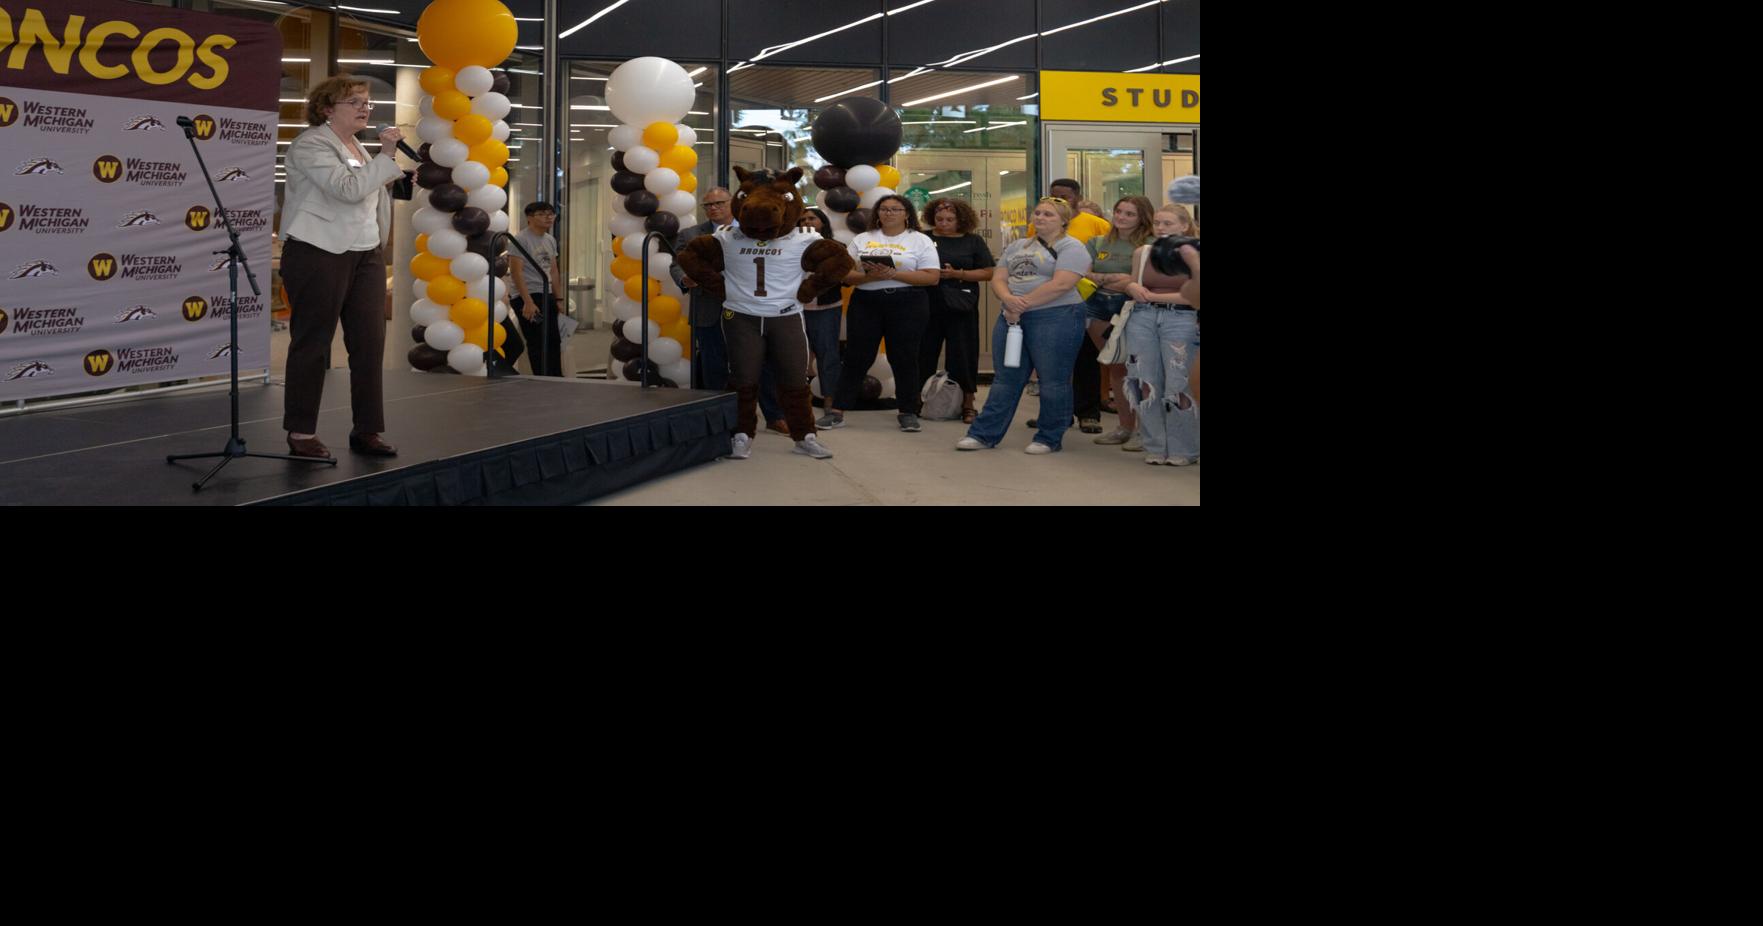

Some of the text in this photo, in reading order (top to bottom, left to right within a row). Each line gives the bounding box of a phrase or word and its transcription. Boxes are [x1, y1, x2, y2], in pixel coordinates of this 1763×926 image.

[0, 7, 237, 90] NCOS
[1101, 87, 1200, 108] STUD
[23, 101, 87, 118] WESTERN
[23, 112, 94, 129] MICHIGAN
[219, 117, 267, 132] WESTERN
[40, 125, 91, 135] UNIVERSITY
[219, 127, 272, 141] MICHIGAN
[231, 138, 268, 146] UNIVERSITY
[97, 160, 119, 179] W
[126, 158, 181, 172] WESTERN
[126, 168, 187, 182] MICHIGAN
[140, 179, 183, 187] UNIVERSITY
[18, 204, 82, 218] WESTERN
[19, 216, 89, 231] MICHIGAN
[213, 217, 267, 230] MCHIGAN
[739, 247, 783, 256] BRONCOS
[121, 254, 176, 266] WESTERN
[92, 258, 113, 277] W
[121, 264, 182, 279] MICHIGAN
[135, 273, 178, 281] UNIVERSITY
[753, 257, 768, 297] 1
[13, 307, 77, 321] WESTERN
[210, 303, 263, 319] MICIGAN
[13, 317, 84, 334] MICHIGAN
[30, 327, 81, 336] UNIVERSITY
[116, 347, 173, 360] WESTERN
[87, 354, 109, 372] W
[116, 354, 179, 372] MICHIGAN
[132, 363, 173, 374] UNIVERSITY
